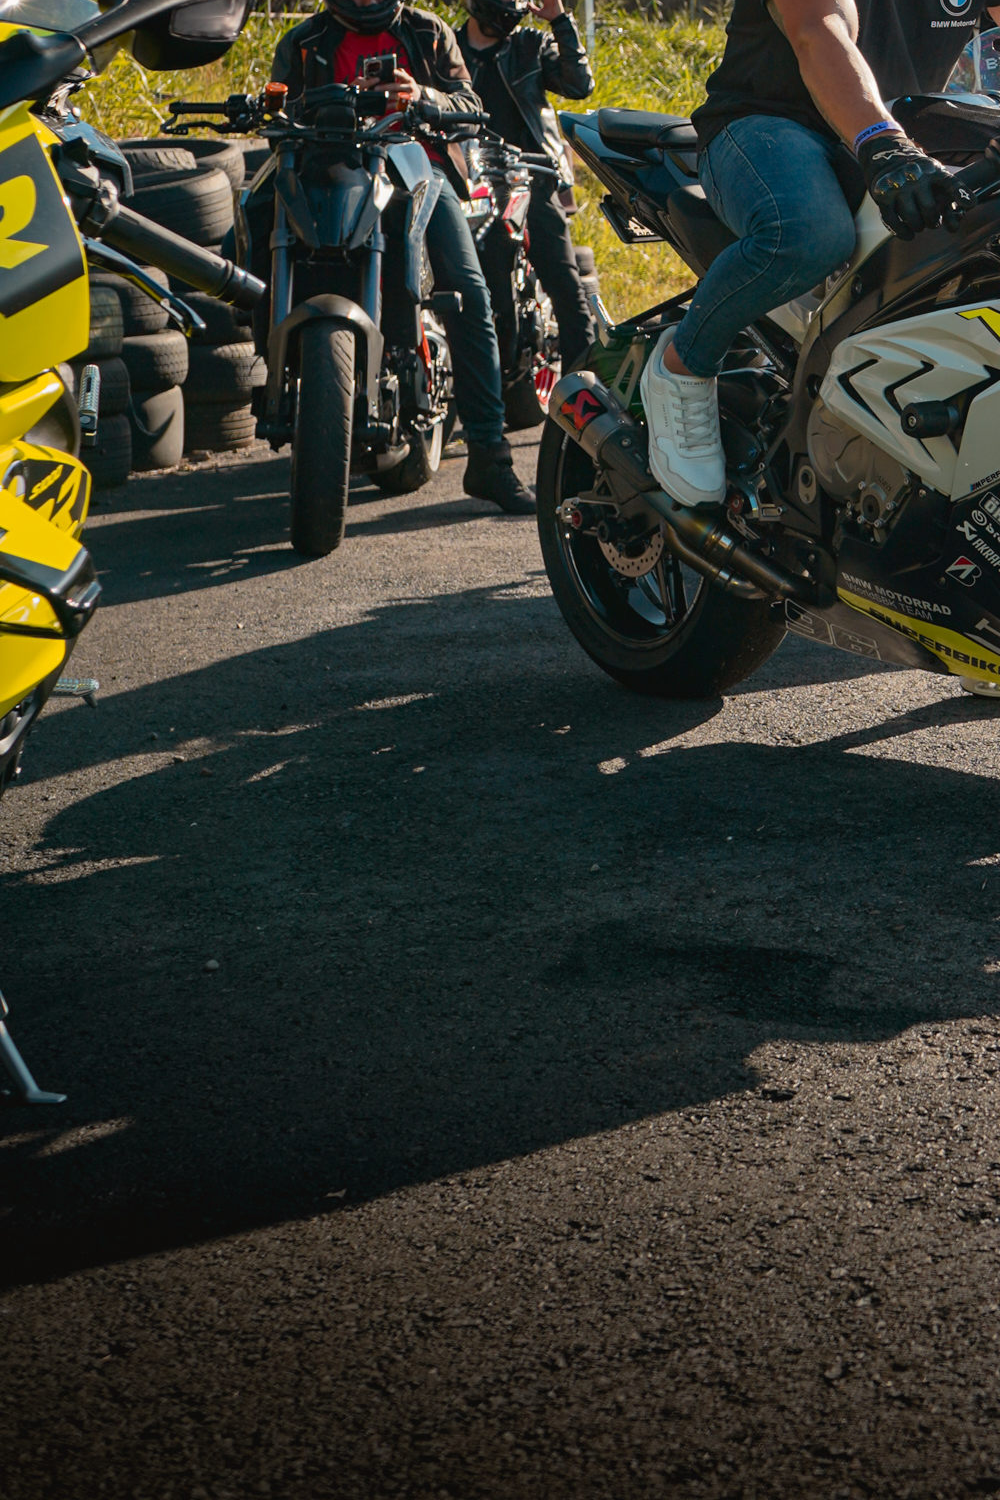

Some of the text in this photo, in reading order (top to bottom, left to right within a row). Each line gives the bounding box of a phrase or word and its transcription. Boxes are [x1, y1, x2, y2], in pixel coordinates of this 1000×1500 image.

[930, 20, 951, 28] BMW
[841, 571, 952, 616] BMW MOTORRAD
[845, 580, 933, 621] WorldSBK TEAM
